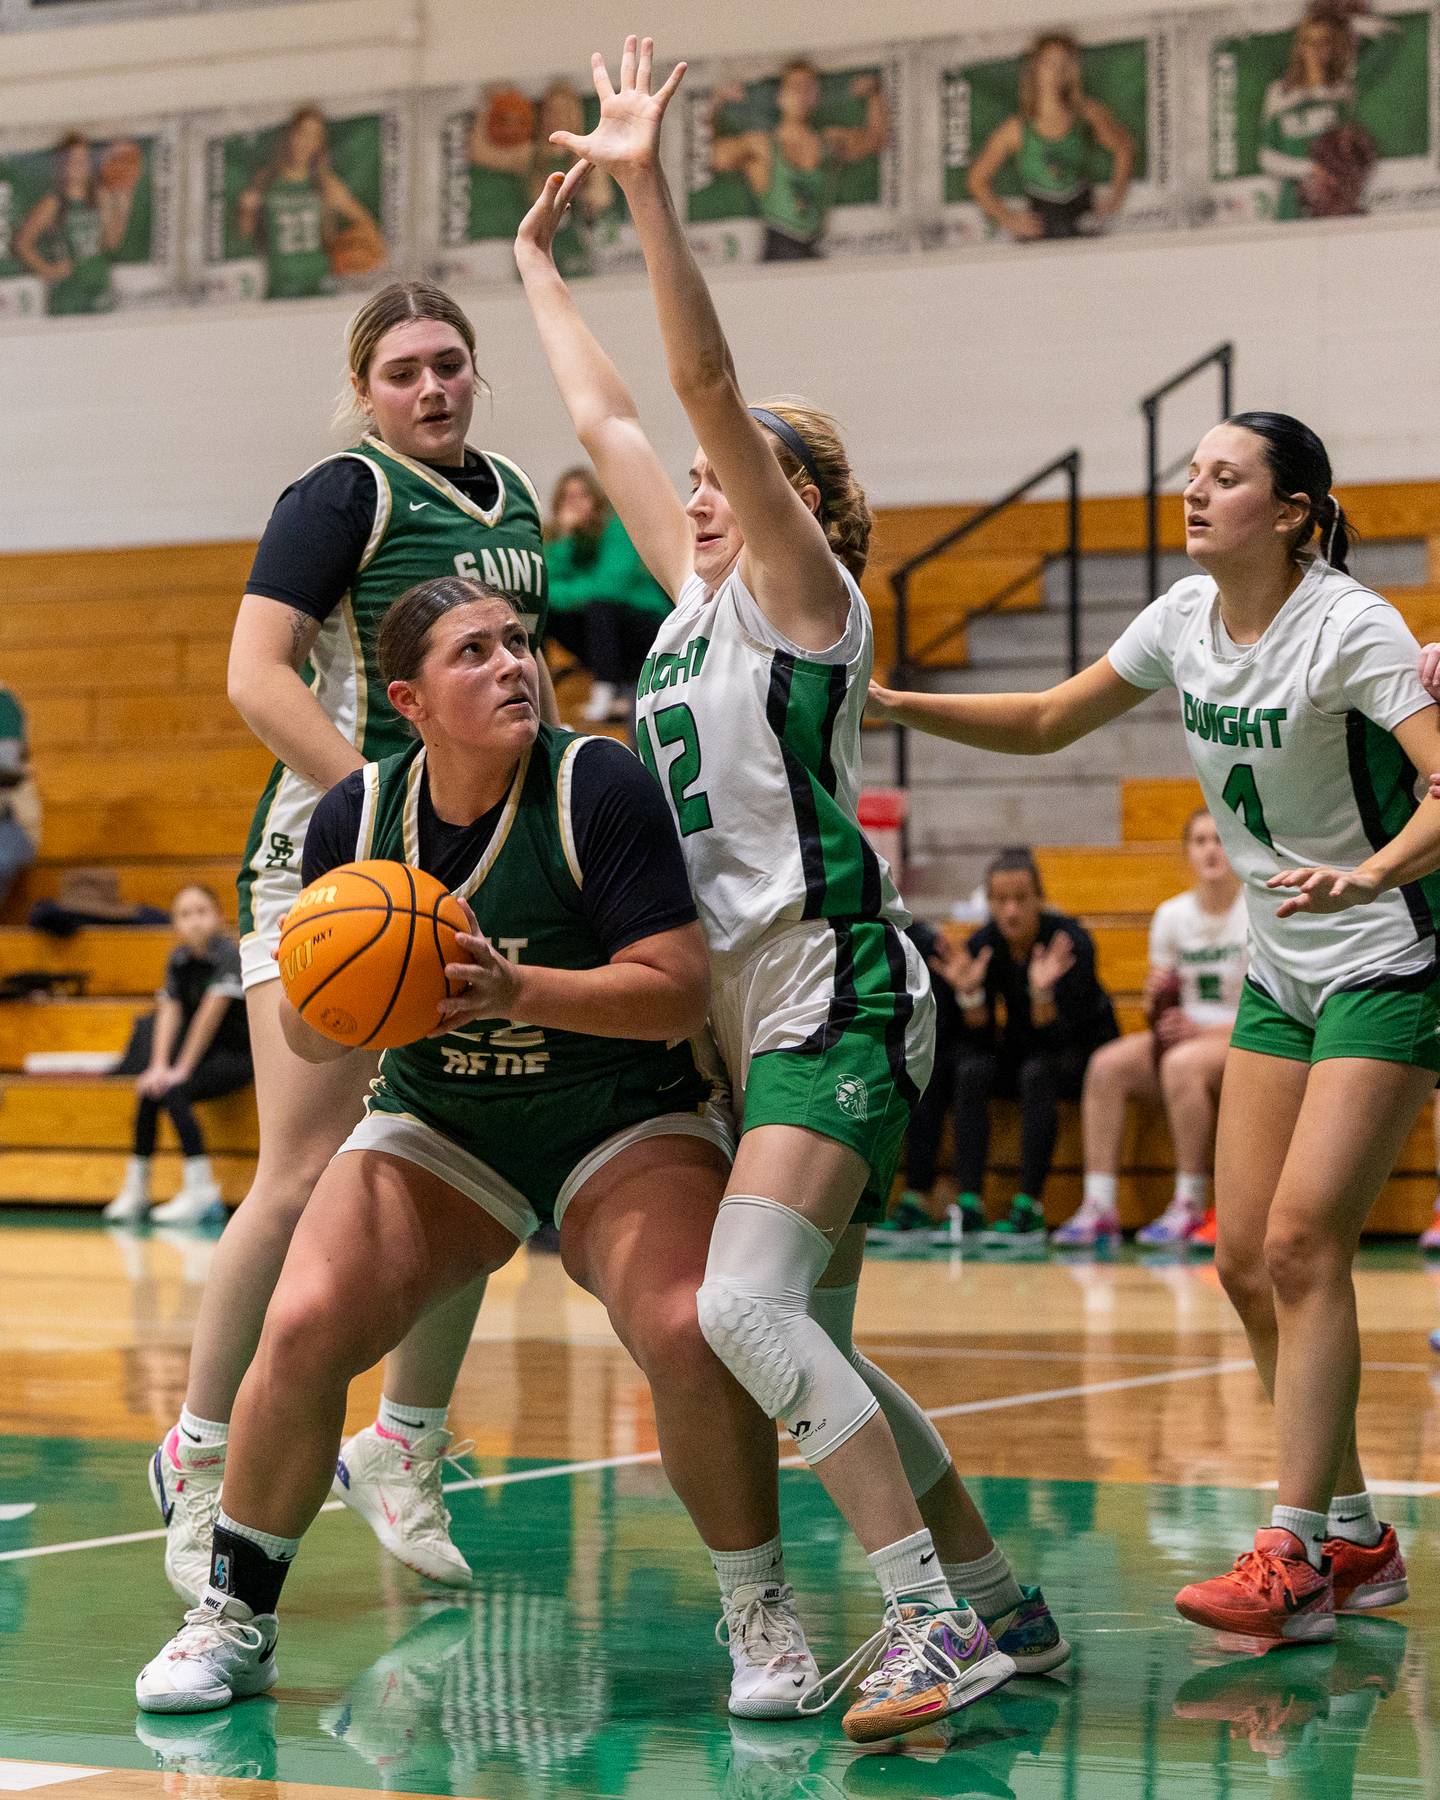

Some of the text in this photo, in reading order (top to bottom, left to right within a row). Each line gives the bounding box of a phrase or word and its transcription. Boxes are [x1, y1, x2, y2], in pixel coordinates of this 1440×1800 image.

[453, 547, 544, 597] SAINT
[1183, 689, 1287, 748] DWIGHT
[204, 1596, 221, 1610] NIKE
[764, 1588, 779, 1599] NIKE
